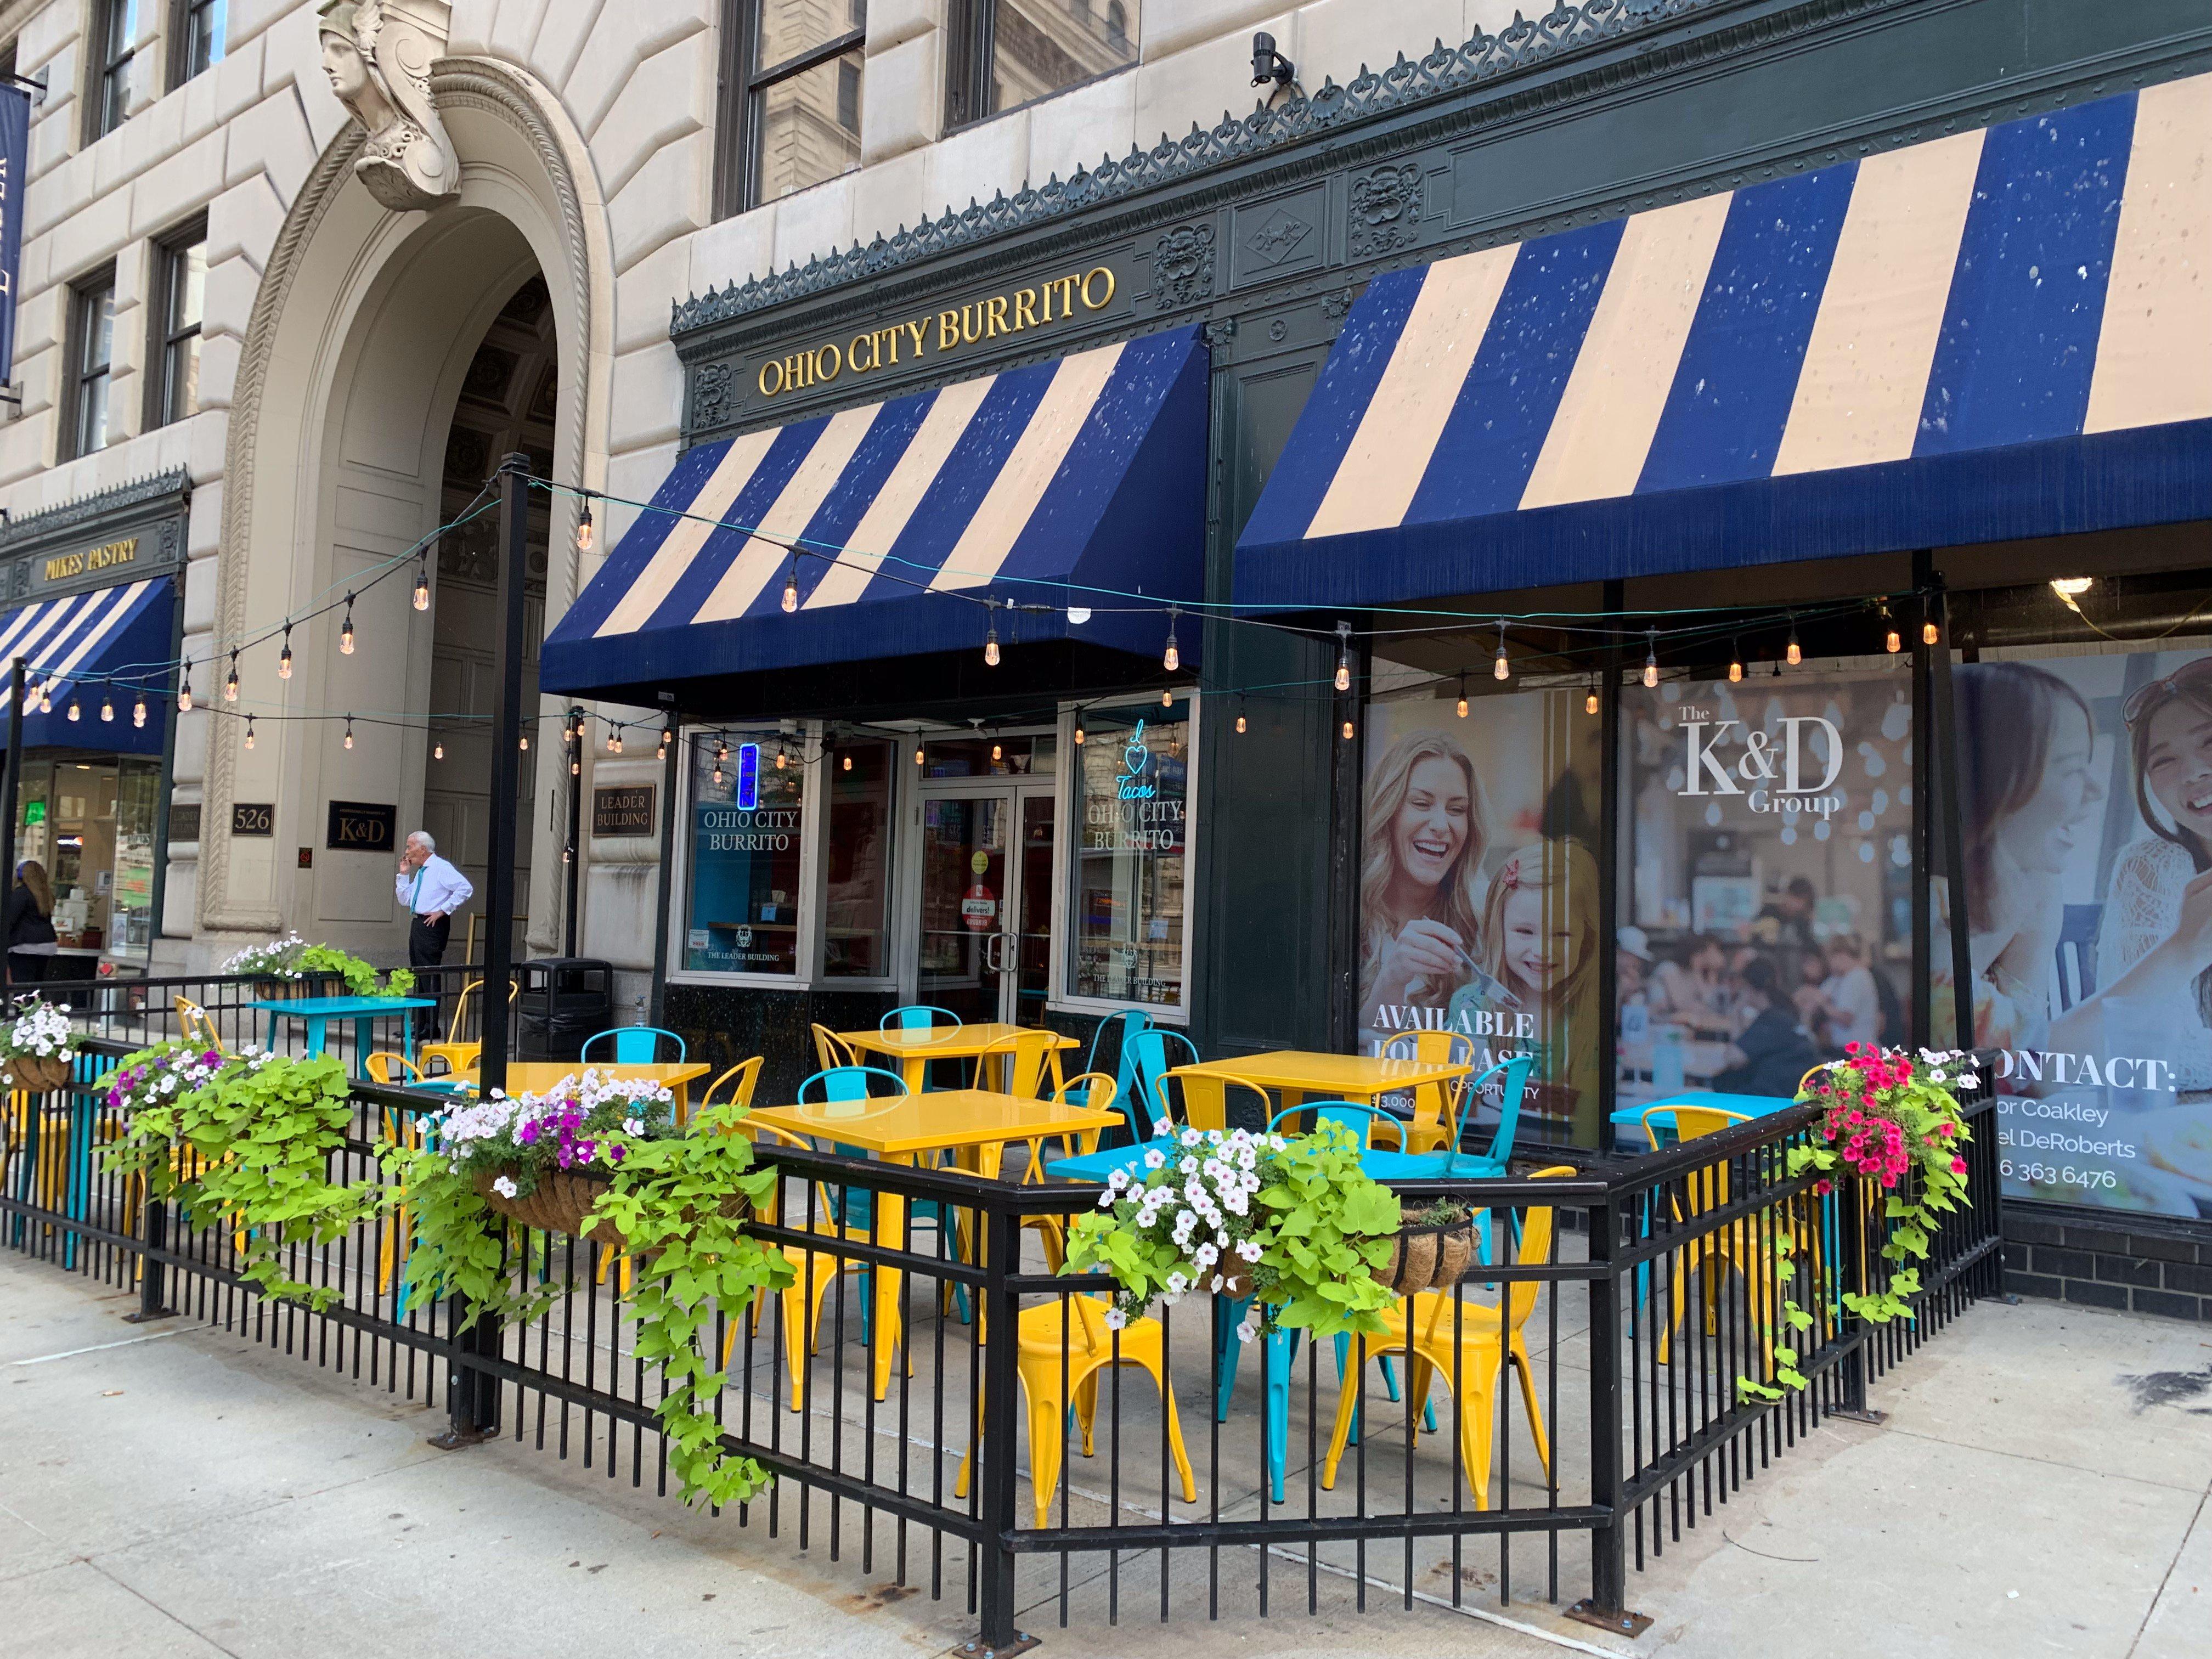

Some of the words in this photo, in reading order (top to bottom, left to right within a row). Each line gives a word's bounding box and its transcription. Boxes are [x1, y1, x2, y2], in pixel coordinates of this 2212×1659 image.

[759, 344, 841, 397] OHIO
[848, 317, 931, 373] CITY
[938, 267, 1115, 351] BURRITO
[44, 552, 84, 582] MIKES
[87, 537, 138, 570] PASTRY
[1679, 706, 1709, 720] The
[1130, 719, 1143, 743] I
[1678, 716, 1843, 795] K&D
[1116, 775, 1156, 799] Tacos
[601, 795, 645, 809] LEADER
[1088, 803, 1136, 824] OHIO
[1139, 800, 1183, 823] CITY
[1748, 790, 1840, 821] Group
[235, 809, 269, 830] 526
[338, 817, 385, 842] K&D
[597, 812, 647, 826] BUILDING
[704, 812, 750, 828] OHIO
[755, 812, 798, 828] CITY
[709, 834, 789, 850] BURRITO
[1094, 829, 1173, 850] BURRITO
[967, 906, 989, 914] delivers!
[721, 952, 746, 960] LEADER
[1093, 974, 1107, 983] THE
[1133, 977, 1166, 986] BUILDING
[1372, 1004, 1534, 1039] AVAILABLE
[1994, 1048, 2176, 1092] ONTACT:
[1450, 1080, 1539, 1099] OPPORTUTY
[2022, 1099, 2109, 1128] Coakley
[2020, 1130, 2136, 1158] DeRoberts
[2018, 1163, 2056, 1184] 363
[2062, 1166, 2117, 1189] 6476
